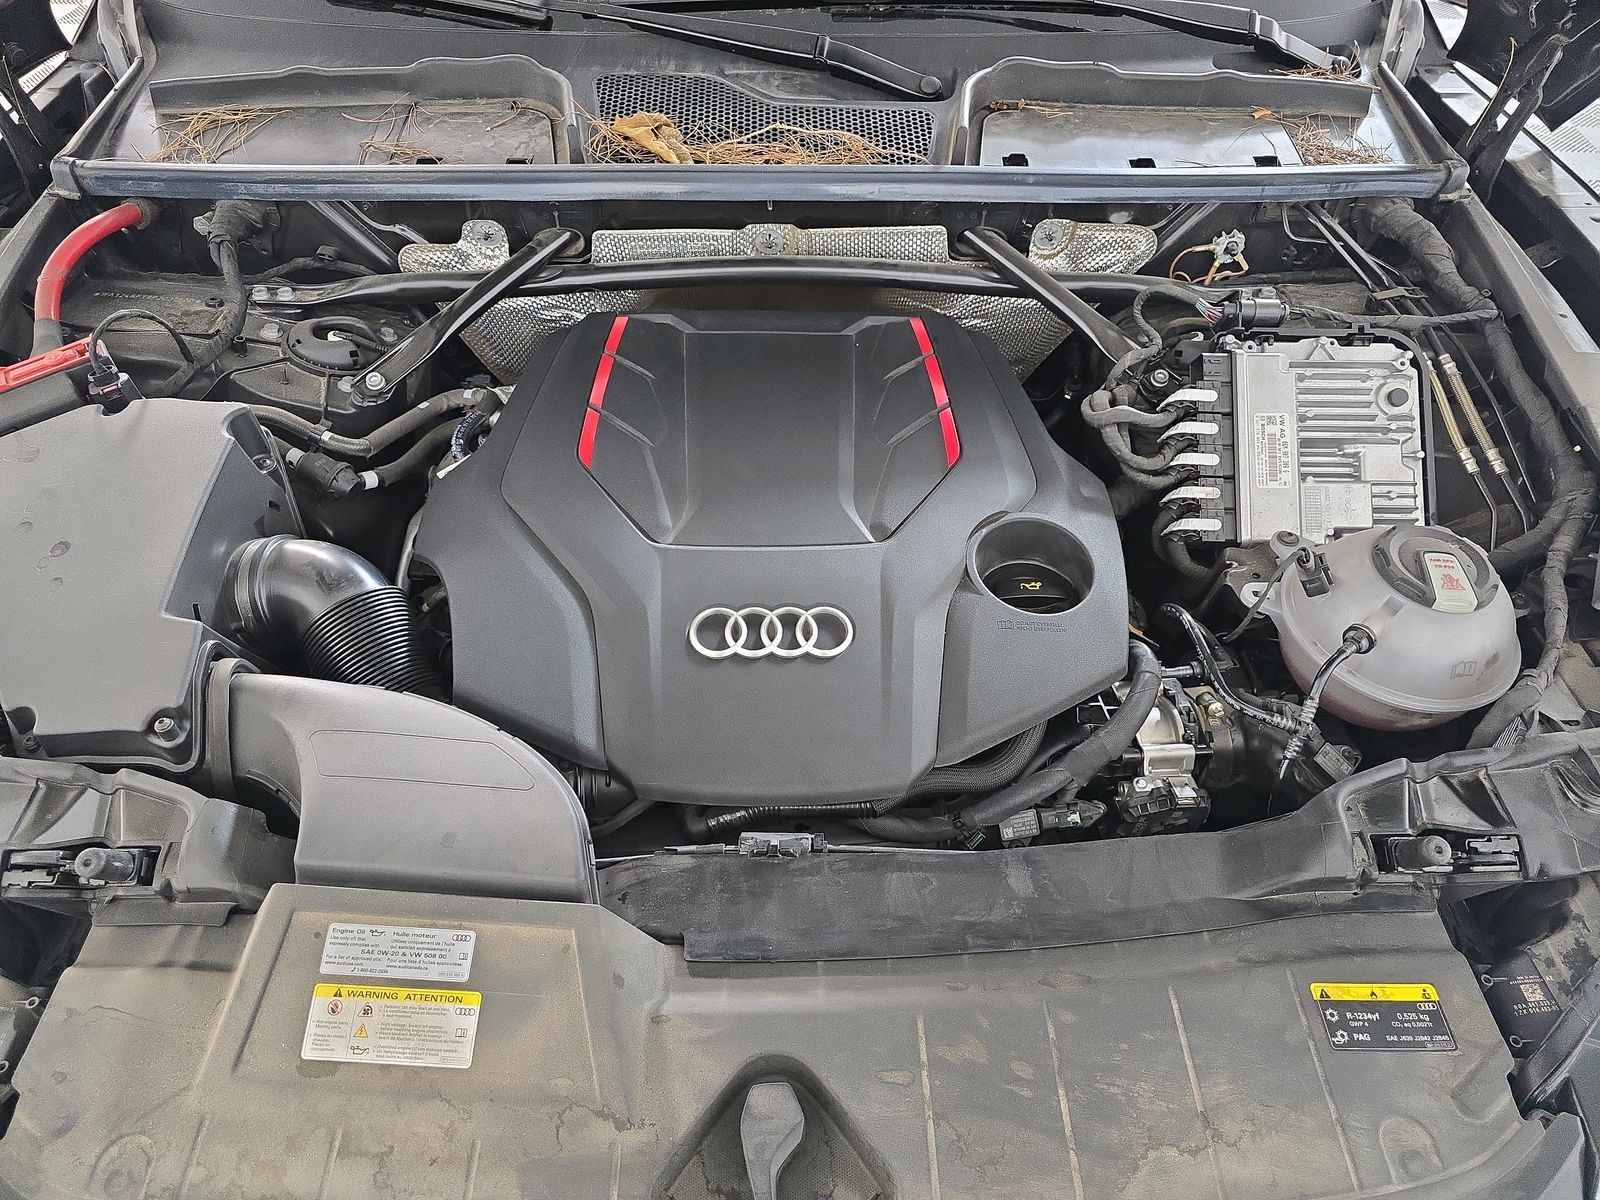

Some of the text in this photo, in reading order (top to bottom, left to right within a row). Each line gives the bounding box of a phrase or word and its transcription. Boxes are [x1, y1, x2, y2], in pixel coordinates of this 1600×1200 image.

[1279, 414, 1286, 427] VW
[1279, 428, 1286, 439] AG
[347, 990, 464, 1003] WARNING ATTENTION
[1345, 1012, 1380, 1021] R-1234yf
[1396, 1012, 1430, 1021] 0,525 kg
[1353, 1033, 1371, 1041] PAG
